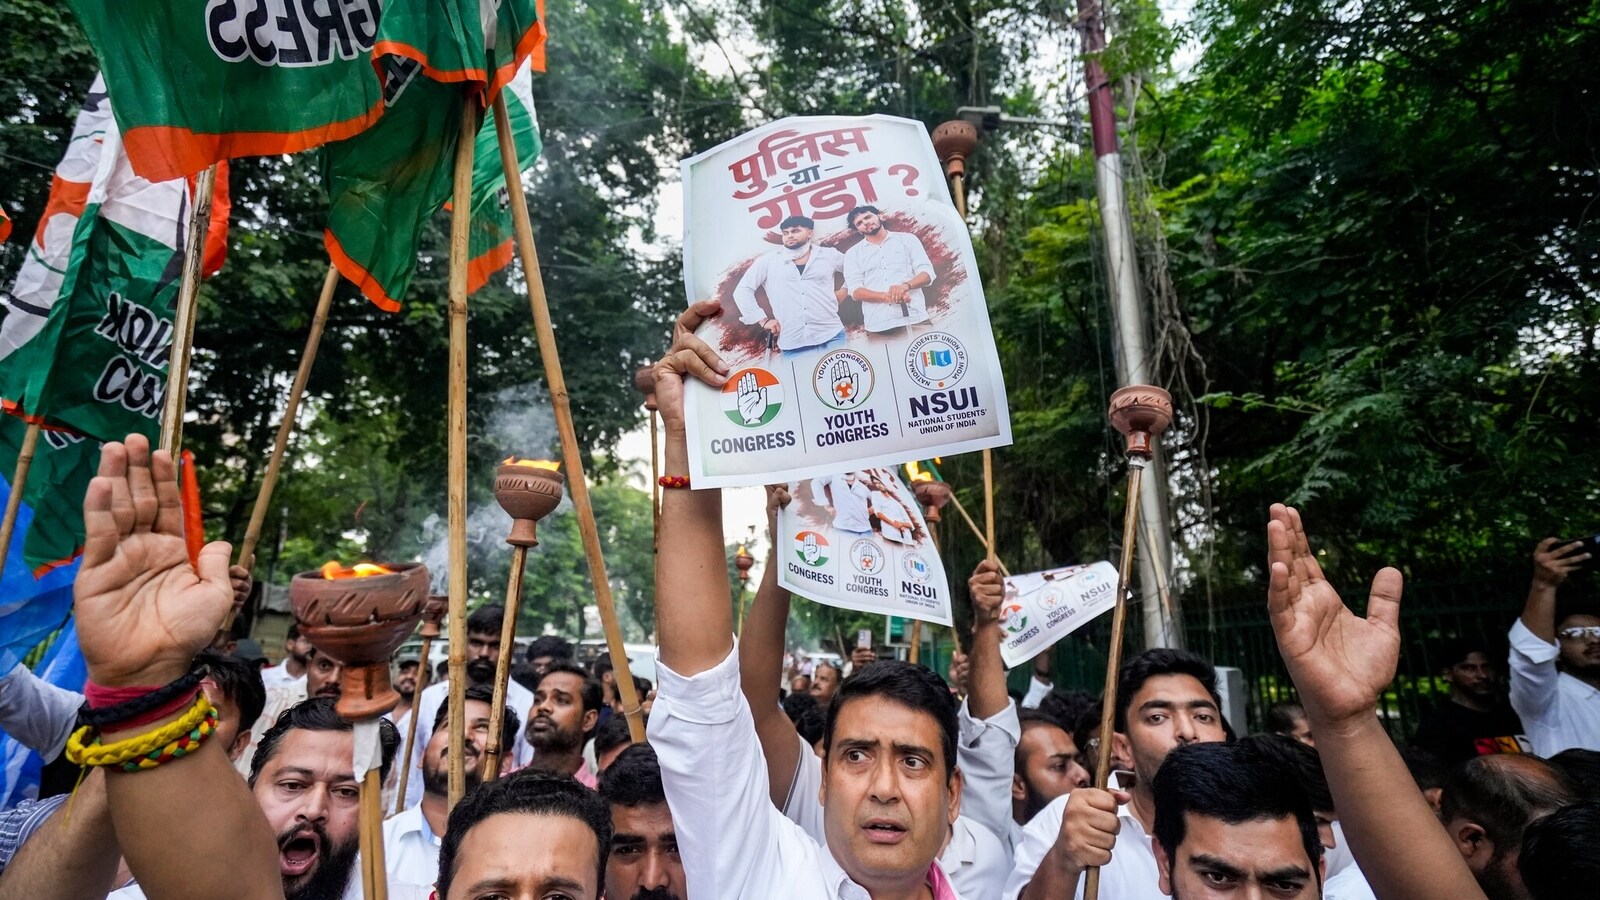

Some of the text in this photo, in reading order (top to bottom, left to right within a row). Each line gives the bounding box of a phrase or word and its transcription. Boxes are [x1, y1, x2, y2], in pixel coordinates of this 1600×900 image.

[728, 126, 873, 200] पुलिस
[788, 164, 821, 185] या
[941, 335, 961, 350] UNION
[957, 350, 965, 360] OF
[818, 353, 869, 380] YOUTH CONGRESS
[909, 358, 931, 387] NATIONAL
[952, 361, 965, 380] INDIA
[909, 386, 979, 418] NSUI
[824, 409, 876, 431] YOUTH
[908, 416, 946, 428] NATIONAL
[920, 419, 977, 435] UNION OF INDIA
[710, 430, 796, 455] CONGRESS
[816, 422, 889, 448] CONGRESS
[788, 562, 834, 585] CONGRESS
[853, 574, 882, 587] YOUTH
[846, 583, 889, 597] CONGRESS
[901, 581, 937, 600] NSUI
[1080, 582, 1111, 602] NSUI
[1046, 604, 1069, 620] YOUTH
[1046, 608, 1077, 629] CONGRESS
[1007, 626, 1040, 650] CONGRESS
